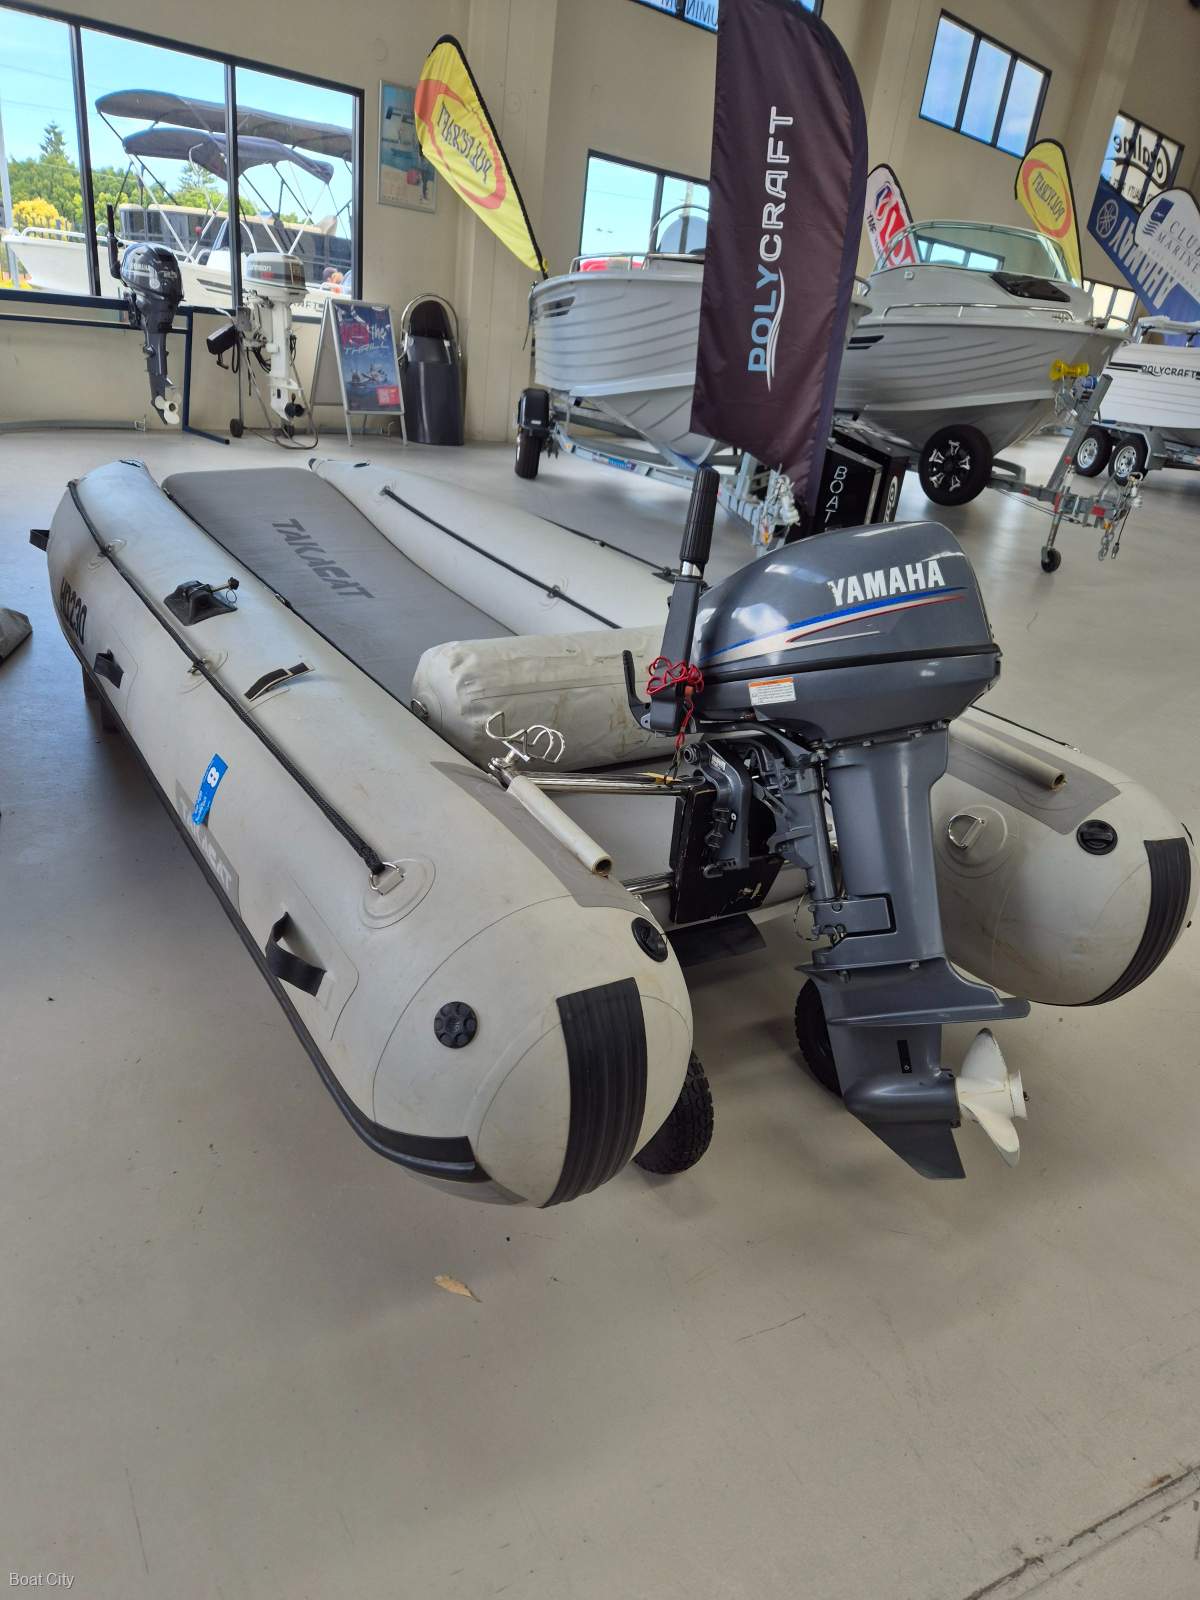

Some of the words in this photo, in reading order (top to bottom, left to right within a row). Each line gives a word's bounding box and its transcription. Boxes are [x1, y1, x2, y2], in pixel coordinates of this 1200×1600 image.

[748, 106, 793, 372] POLYCRAFT
[1141, 365, 1197, 379] POLYCRAFT
[825, 466, 848, 523] BOAT
[272, 518, 376, 599] TAKACAT
[827, 559, 946, 606] YAMAHA
